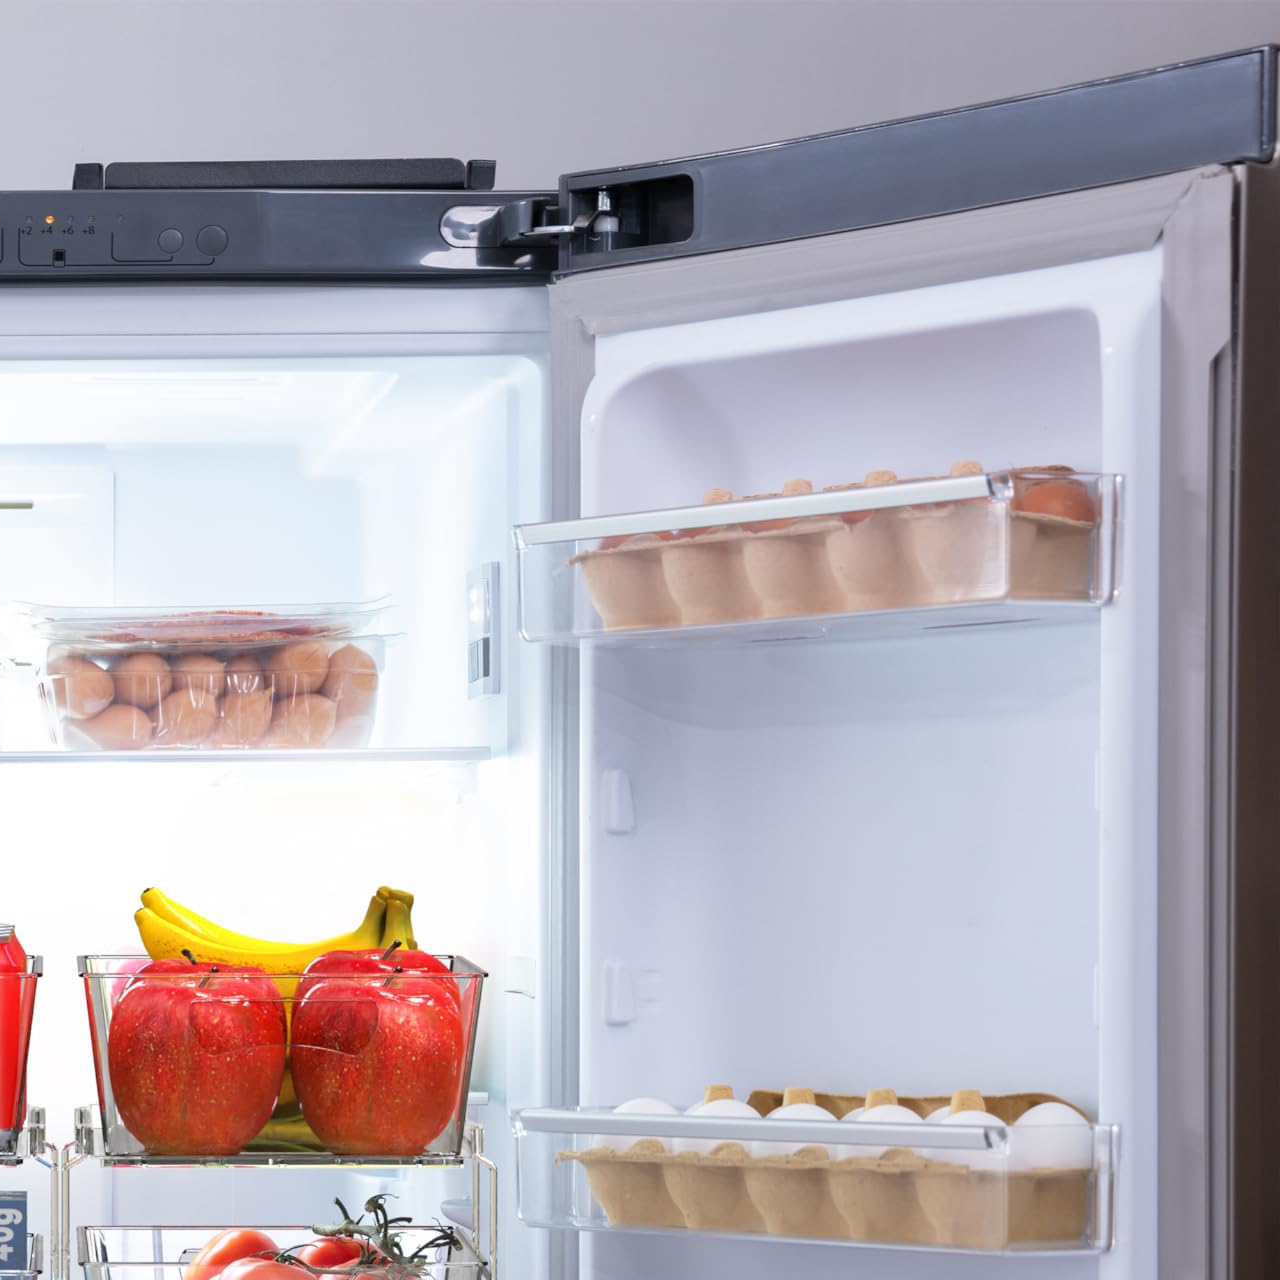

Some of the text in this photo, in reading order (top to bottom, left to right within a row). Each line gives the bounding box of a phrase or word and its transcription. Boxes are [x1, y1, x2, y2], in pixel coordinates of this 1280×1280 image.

[21, 226, 95, 236] +2 +4 +6 +8
